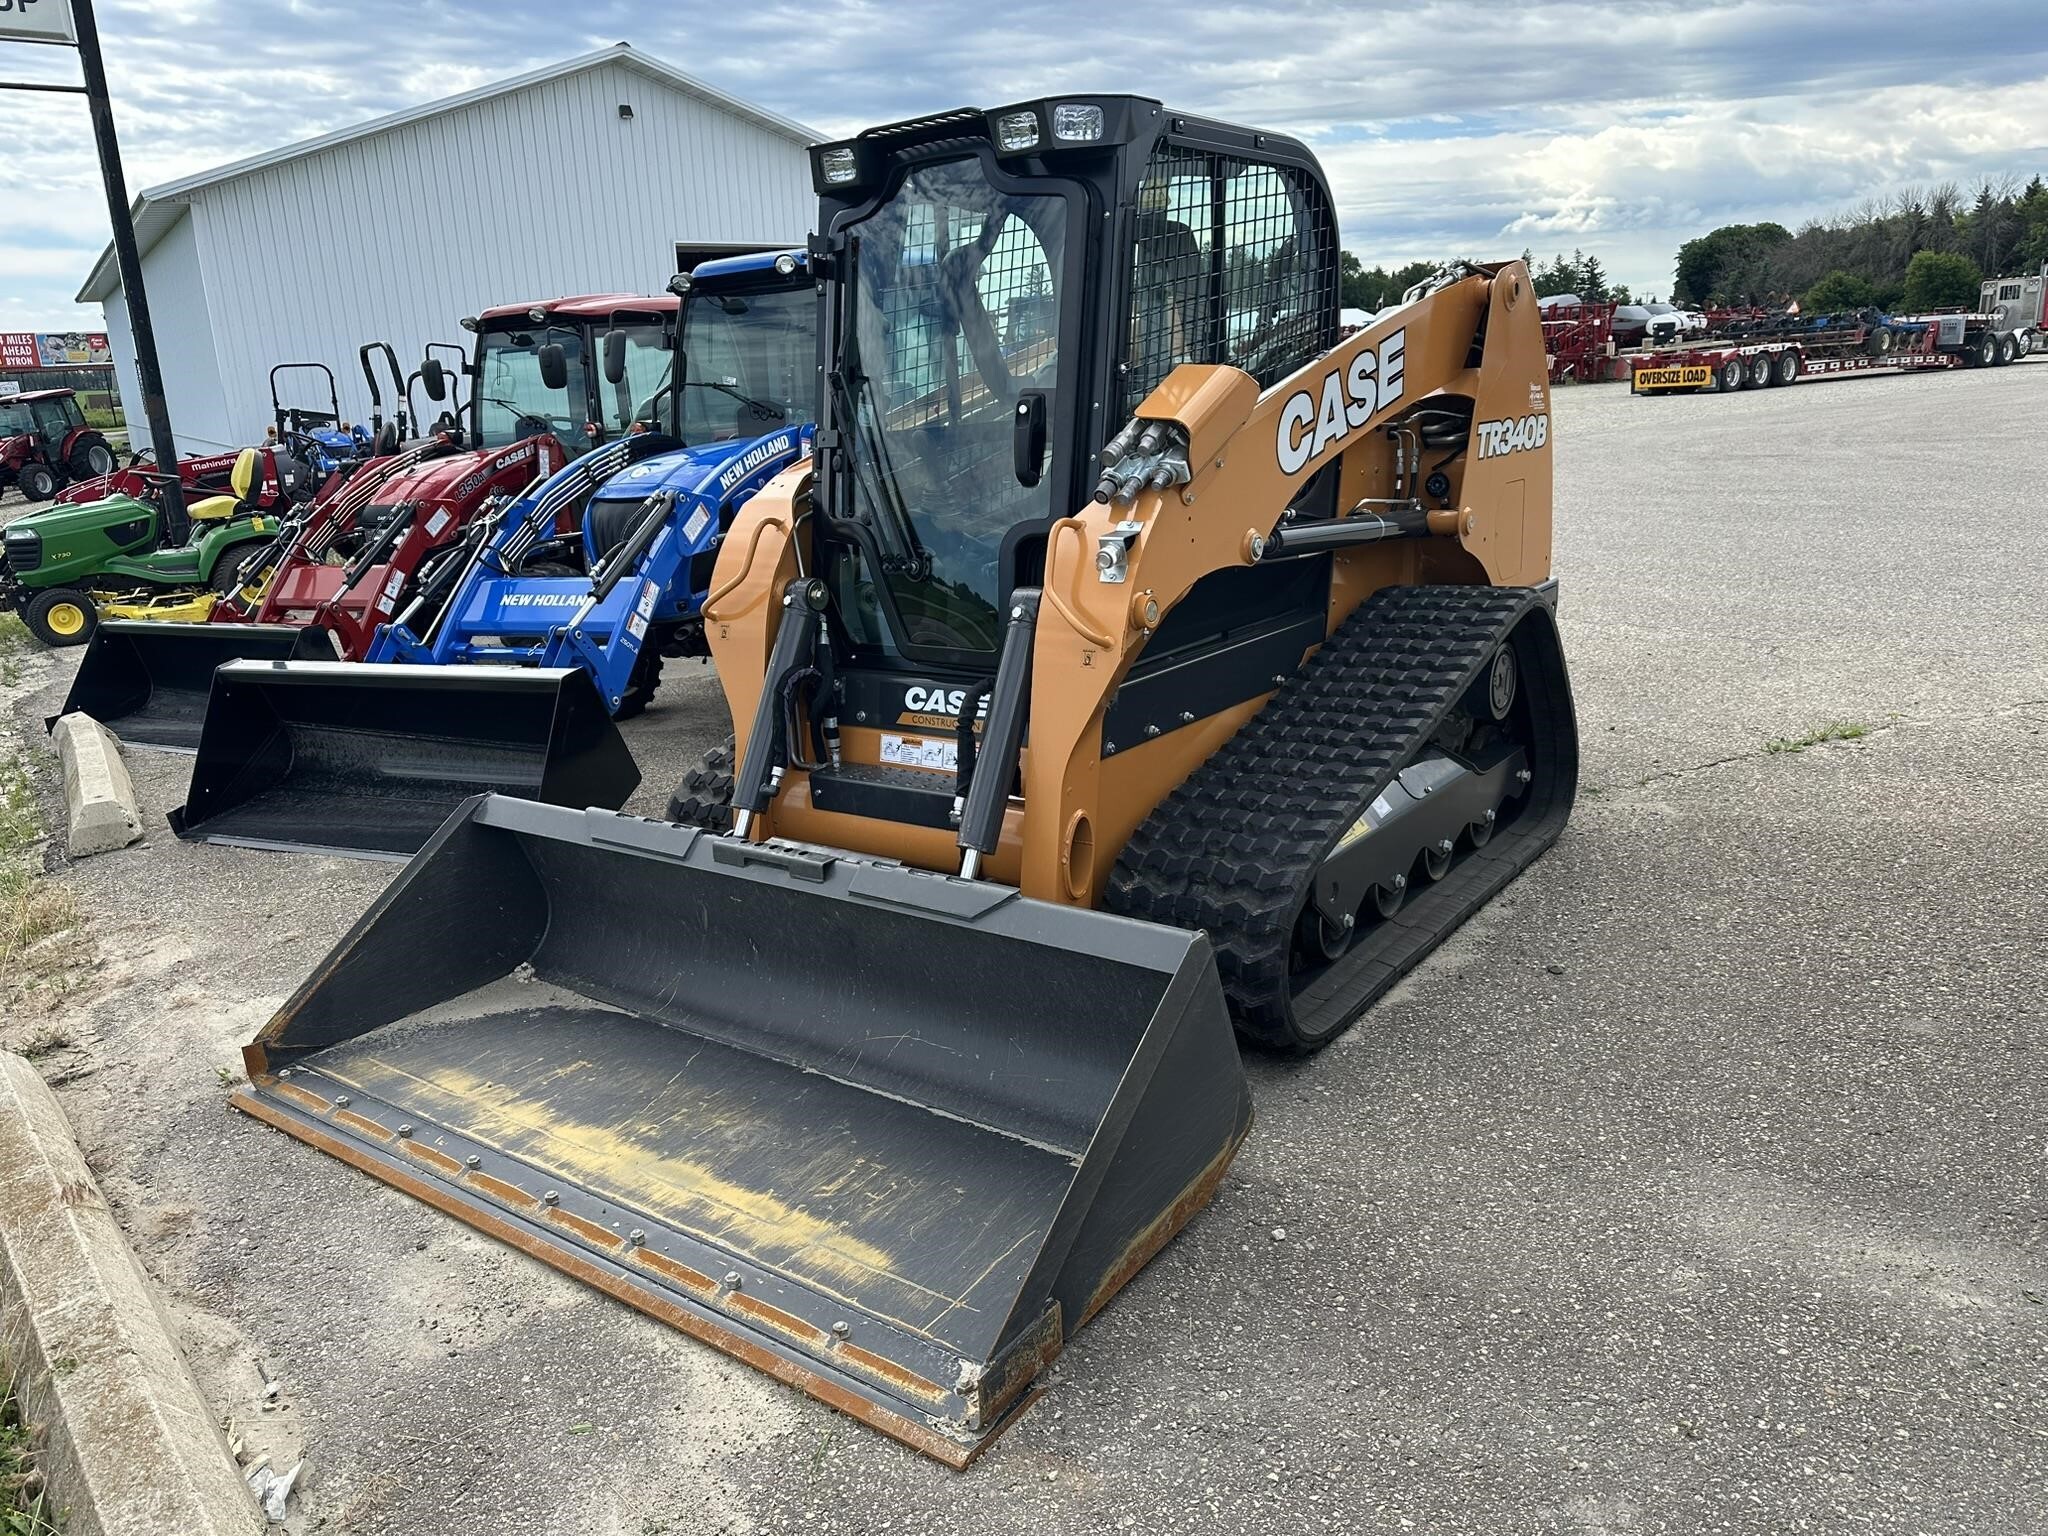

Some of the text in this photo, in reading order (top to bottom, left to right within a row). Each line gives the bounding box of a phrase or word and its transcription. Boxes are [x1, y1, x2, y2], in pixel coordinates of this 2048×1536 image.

[6, 335, 33, 345] MILES
[2, 346, 32, 356] AHEAD
[6, 356, 33, 366] BYRON
[1639, 369, 1706, 384] OVERSIZE LOAD
[1276, 326, 1406, 476] CASE
[1477, 413, 1548, 460] TR340B
[191, 458, 236, 471] Mahindra
[495, 448, 526, 469] CASE
[719, 434, 789, 490] NEW HOLLAND
[500, 594, 588, 607] NEW HOLLAN
[911, 715, 981, 730] CONSTRUCN
